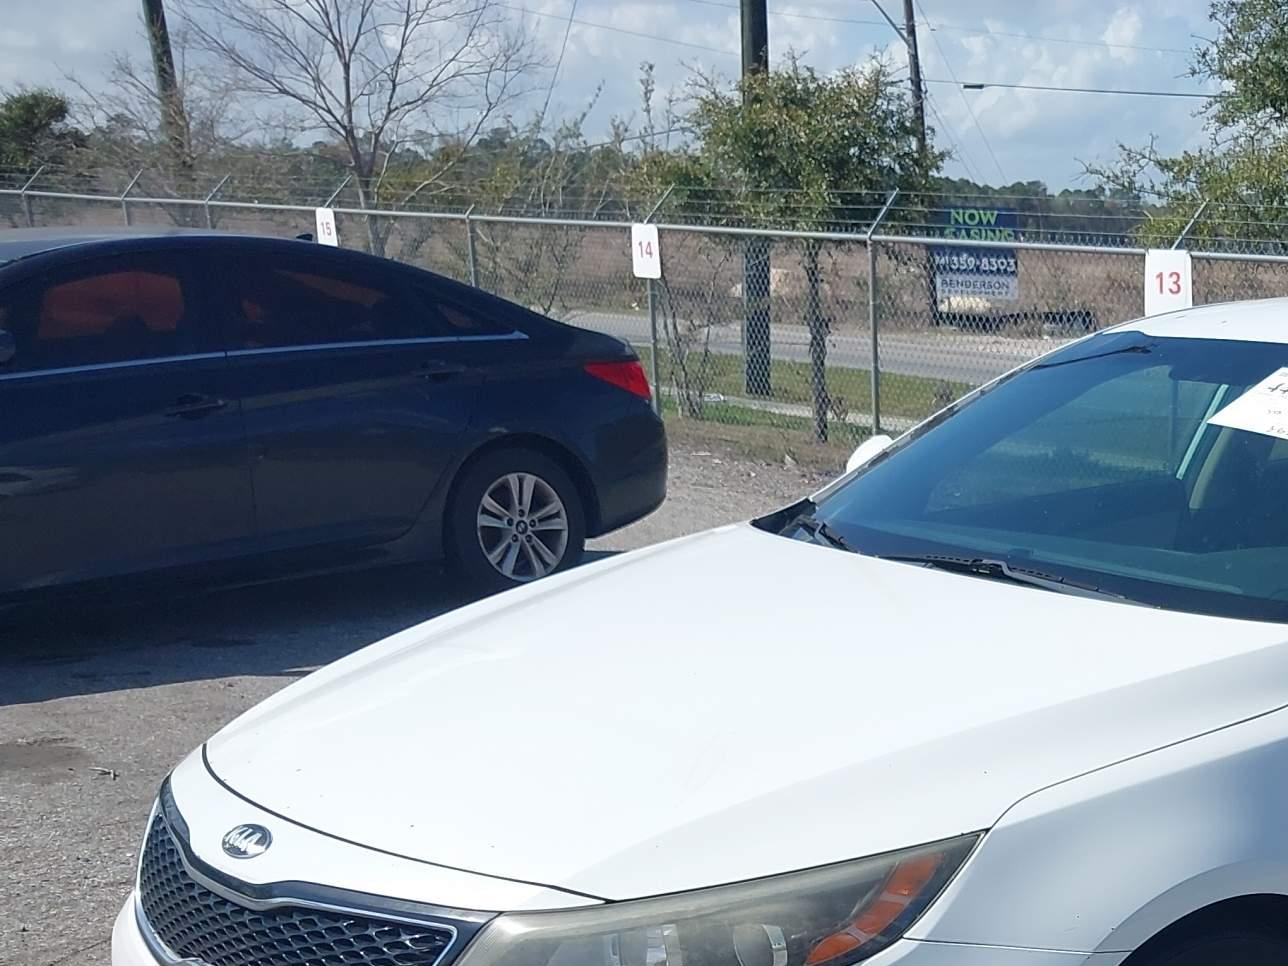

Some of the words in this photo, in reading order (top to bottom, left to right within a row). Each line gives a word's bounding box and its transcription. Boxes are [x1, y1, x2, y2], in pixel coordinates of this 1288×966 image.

[950, 208, 998, 226] NOW
[320, 221, 332, 236] 15
[638, 240, 654, 259] 14
[1155, 271, 1182, 295] 13
